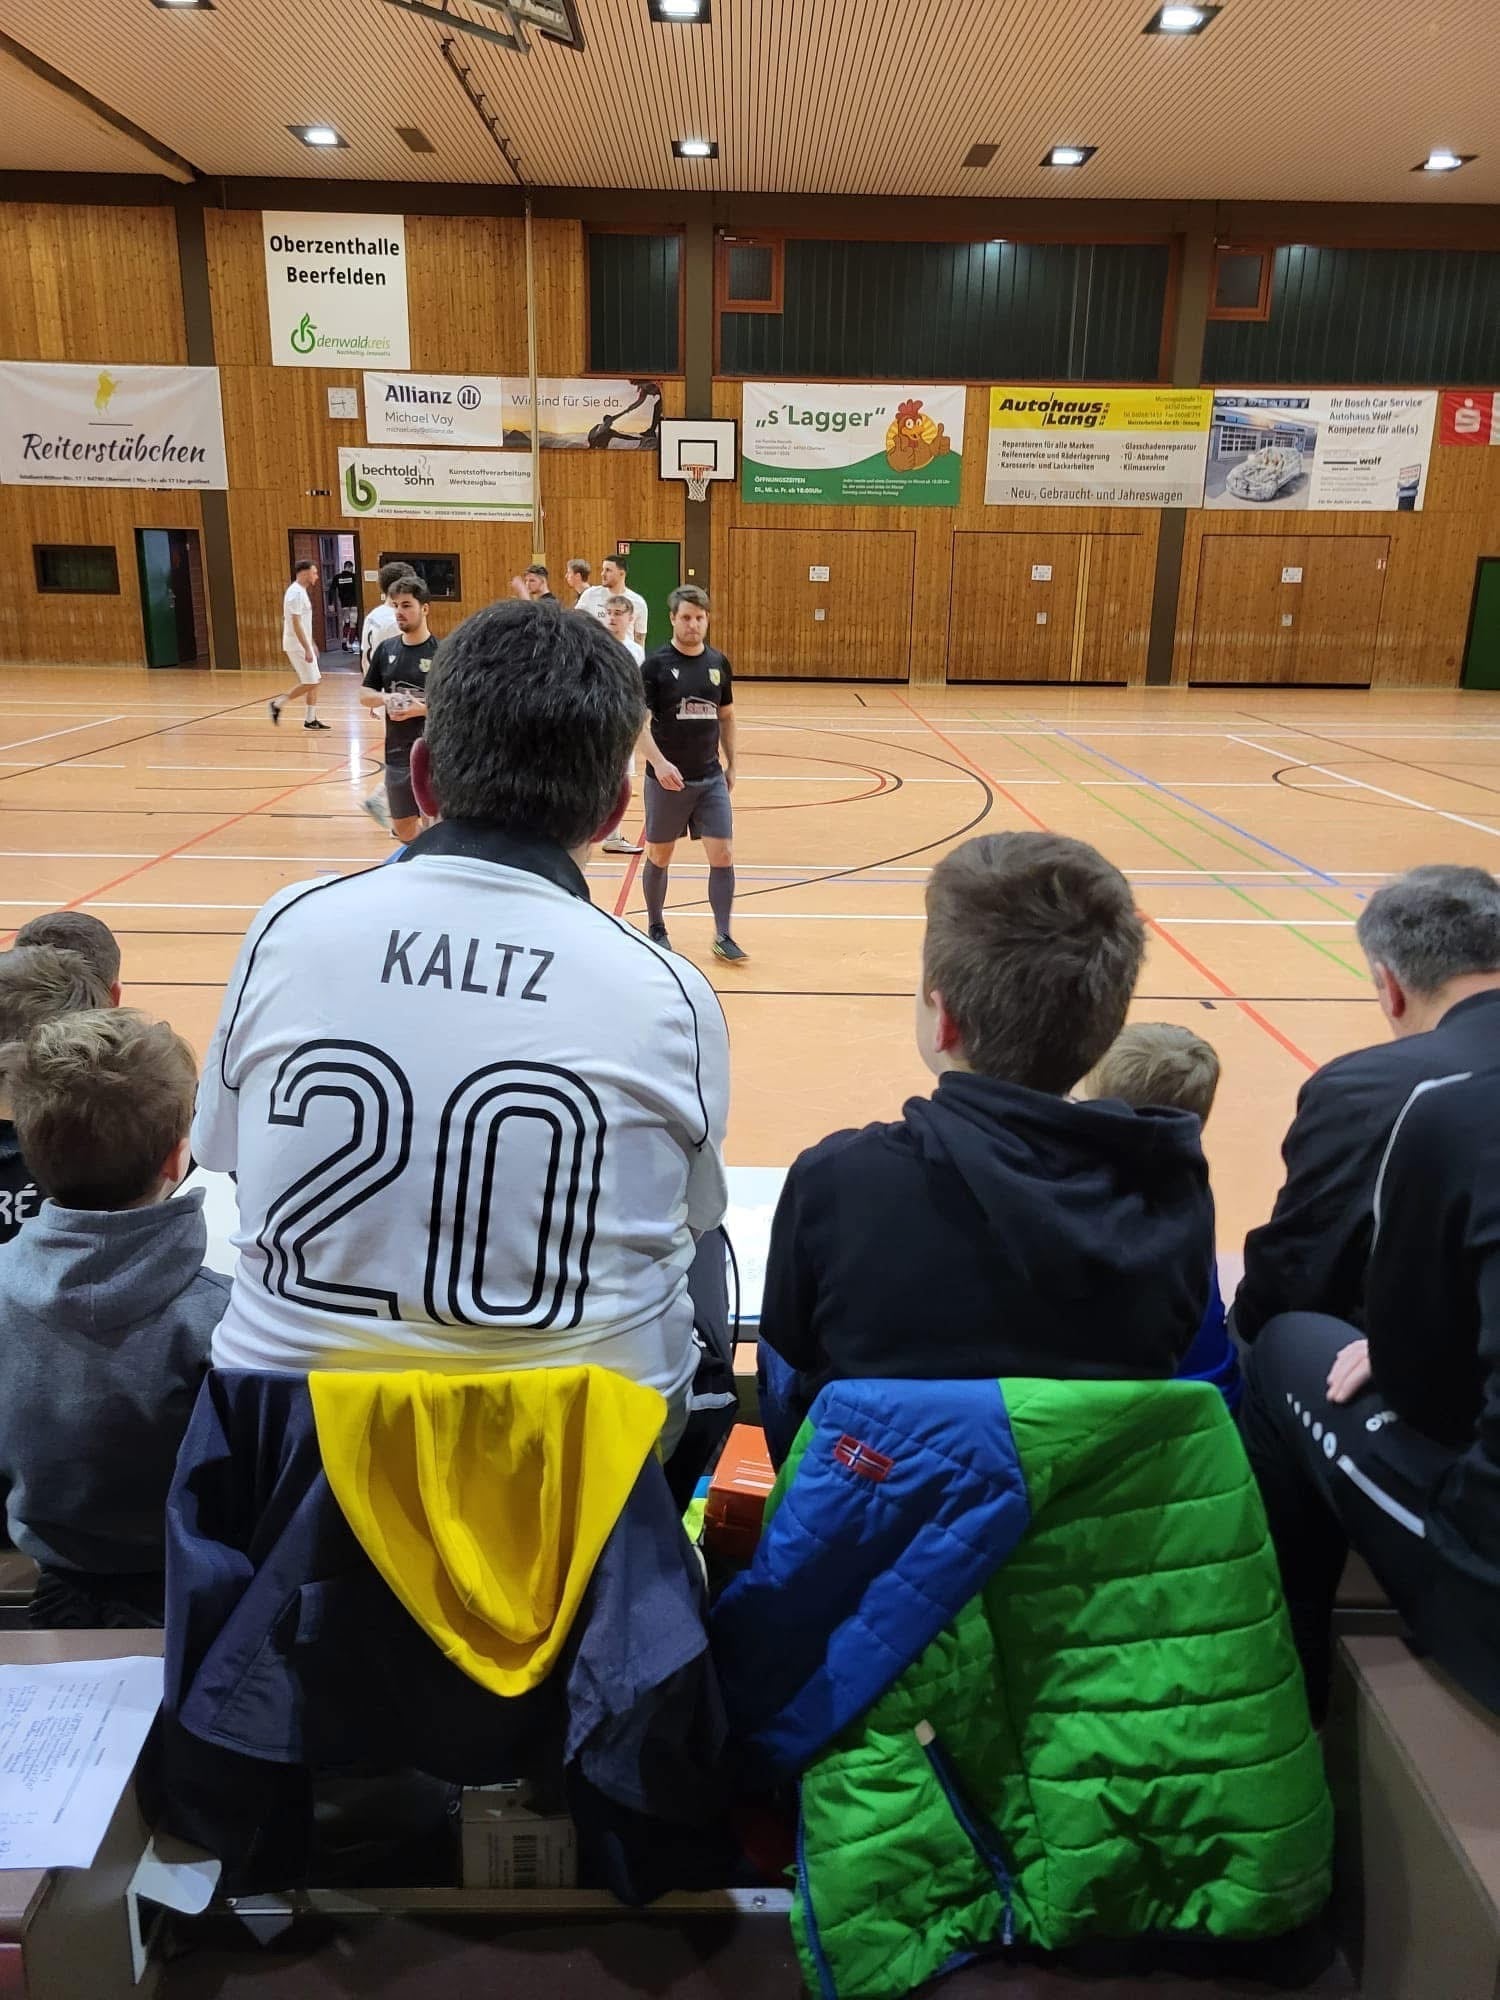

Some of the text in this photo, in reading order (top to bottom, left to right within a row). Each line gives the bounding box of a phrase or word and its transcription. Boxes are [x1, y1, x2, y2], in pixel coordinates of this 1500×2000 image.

[270, 235, 400, 256] Oberzenthalle
[287, 266, 386, 285] Beerfelden
[385, 385, 452, 404] Allianz
[563, 395, 579, 407] für
[583, 396, 600, 407] Sie
[603, 396, 622, 407] da.
[999, 398, 1103, 413] Autohaus
[1330, 397, 1422, 408] Ihr Bosch Car Service
[385, 412, 428, 423] Michael
[1046, 413, 1098, 428] Lang
[1330, 411, 1370, 420] Autohaus
[1372, 411, 1392, 420] Wolf
[1328, 424, 1419, 436] Kompetenz für alle(s)
[22, 433, 206, 463] Reiterstübchen
[1003, 440, 1094, 449] Reparaturen für alle Marken
[1125, 442, 1197, 452] Glasschadenreparatur
[1001, 451, 1045, 459] Reifenservice
[1061, 452, 1110, 462] Räderlagerung
[1359, 456, 1382, 465] wolf
[362, 464, 417, 476] bechtold
[1053, 462, 1095, 470] Lackarbeiten
[449, 469, 531, 478] Kunststoffverarbeitung
[404, 475, 435, 486] sohn
[450, 479, 496, 487] Werkzeugbau
[1011, 487, 1183, 505] Neu-, Gebraucht- und Jahreswagen
[380, 929, 555, 1003] KALTZ
[256, 1039, 606, 1330] 20
